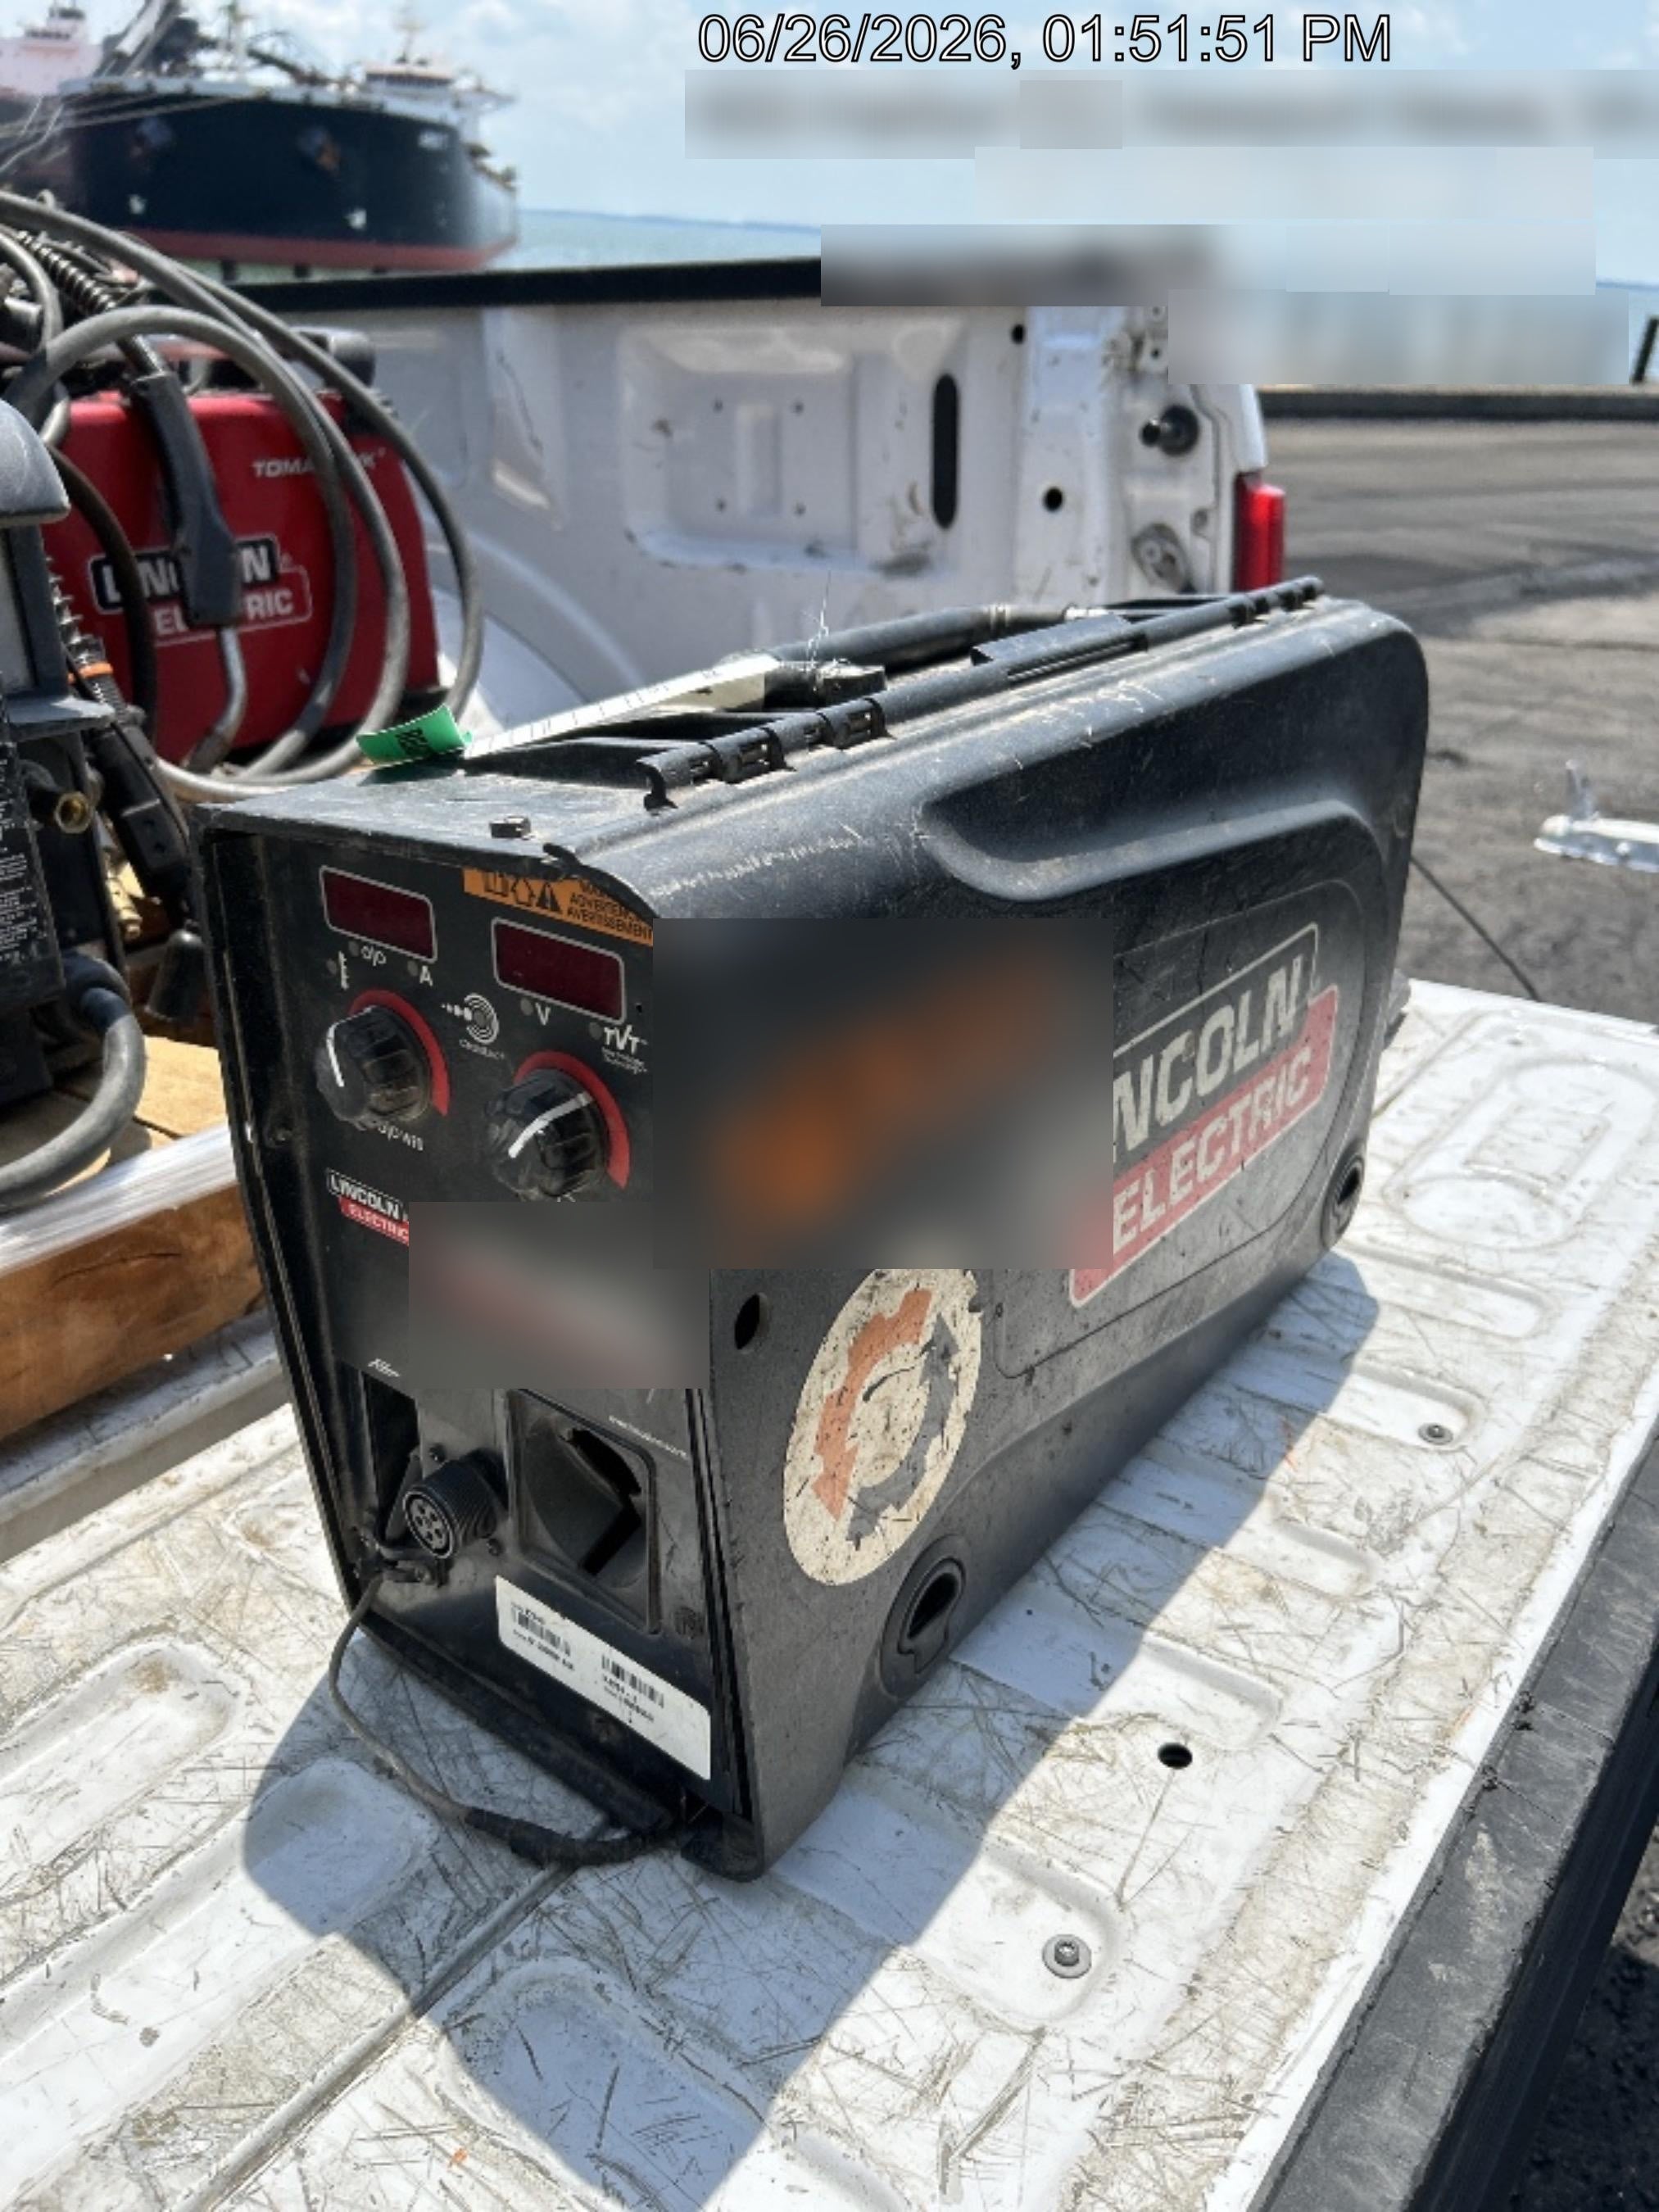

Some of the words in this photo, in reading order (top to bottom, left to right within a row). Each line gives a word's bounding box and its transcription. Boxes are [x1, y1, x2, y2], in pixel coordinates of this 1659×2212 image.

[252, 453, 377, 478] TOMAK
[154, 587, 296, 636] ELRIC
[419, 965, 433, 986] A
[535, 1002, 551, 1026] V
[1114, 1045, 1311, 1252] ELECTRIC
[329, 1172, 401, 1221] LINCOLN
[349, 1203, 409, 1240] ELECTRIC
